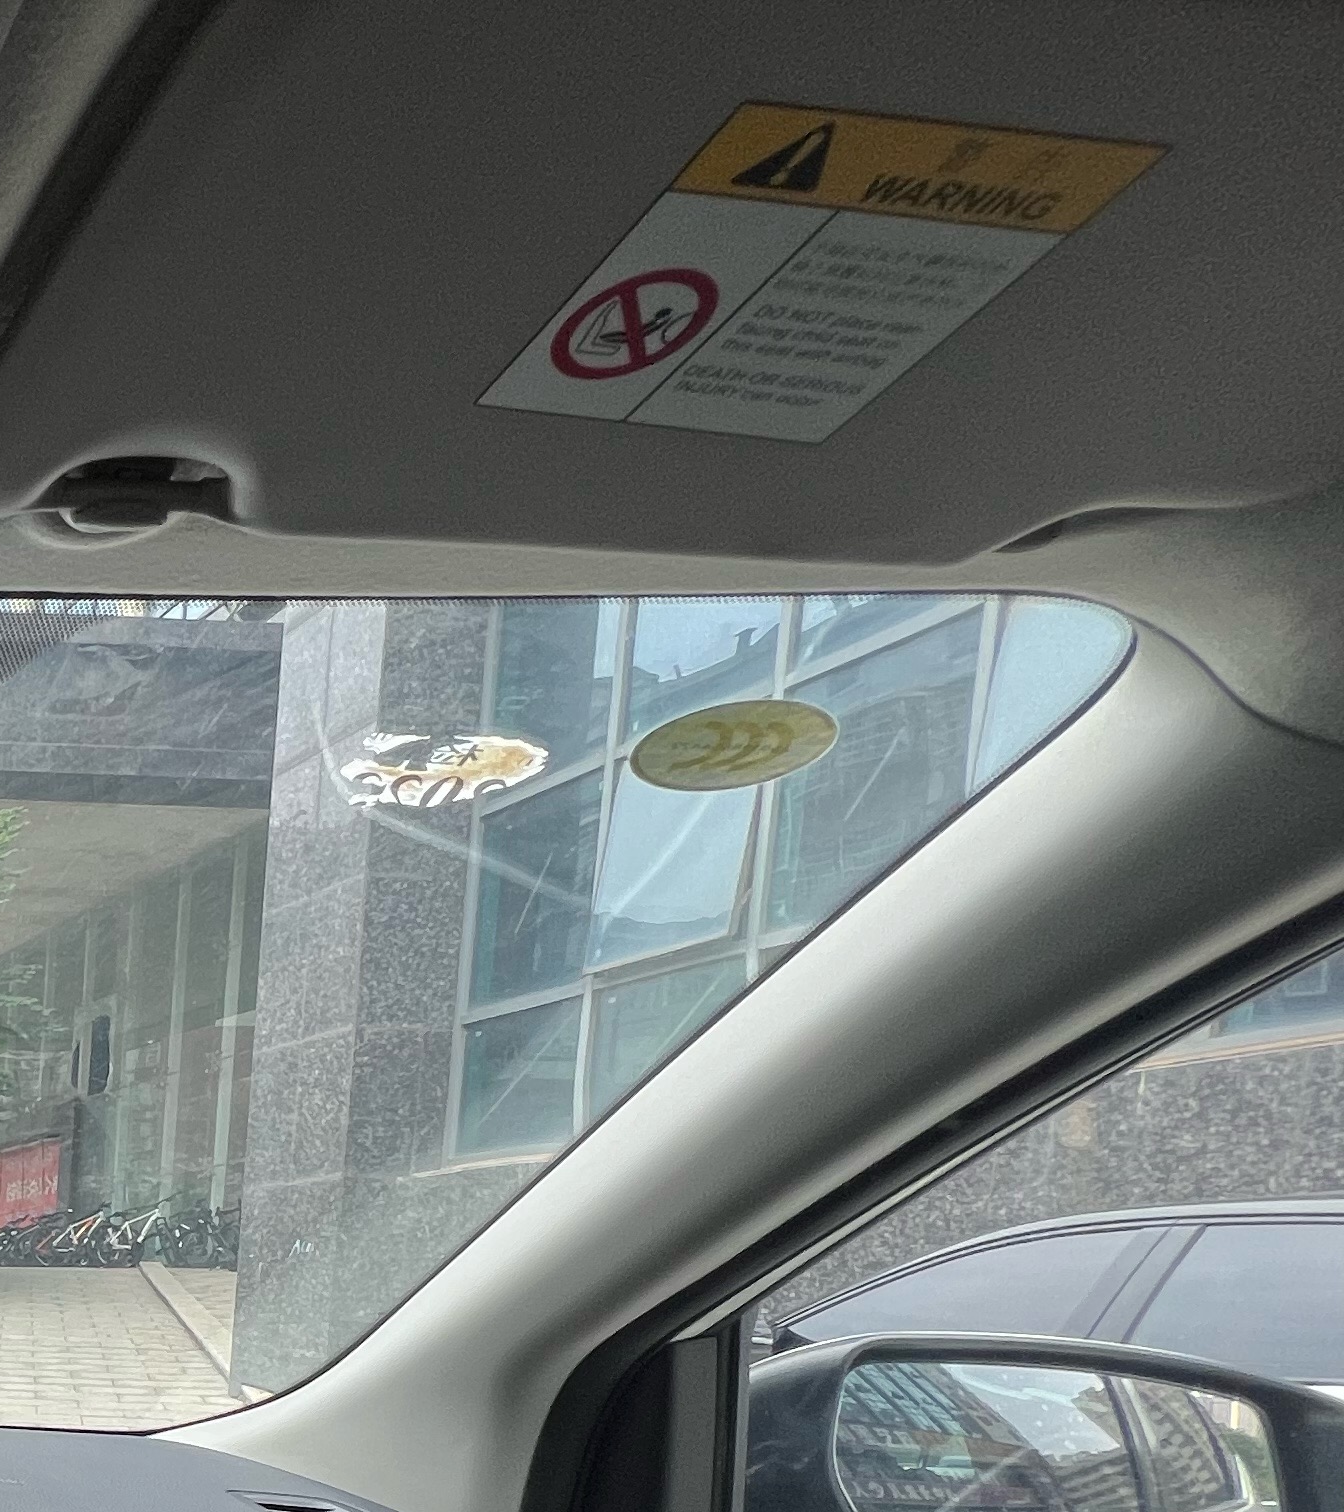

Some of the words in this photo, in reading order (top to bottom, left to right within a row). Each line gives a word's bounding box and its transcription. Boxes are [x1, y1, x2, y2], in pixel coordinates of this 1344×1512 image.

[865, 174, 1063, 221] WARNING
[751, 303, 791, 320] DO
[783, 308, 836, 325] NOT
[680, 363, 752, 382] DEATH
